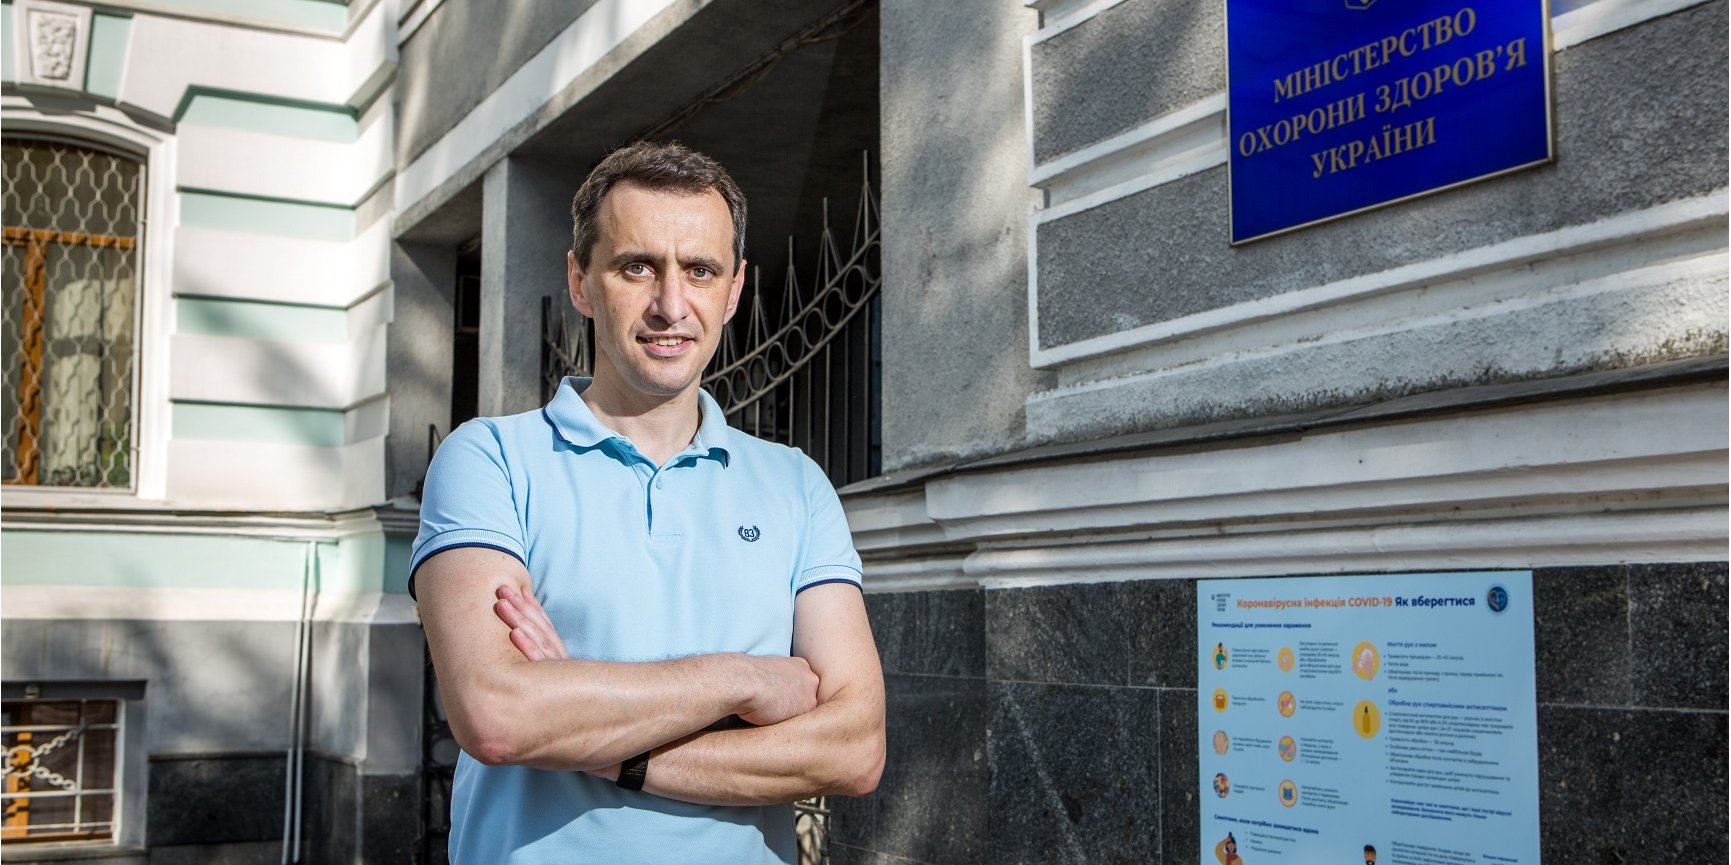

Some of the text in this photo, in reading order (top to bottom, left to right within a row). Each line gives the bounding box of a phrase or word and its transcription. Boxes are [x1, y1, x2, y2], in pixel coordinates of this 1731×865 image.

[1273, 8, 1477, 103] МІНІСТЕРСТВО
[1239, 93, 1366, 157] ОХОРОНИ
[1311, 117, 1437, 179] УКРАЇНИ
[1237, 597, 1301, 609] Коронавірусна
[1304, 596, 1345, 609] інфекція
[1348, 597, 1392, 607] COVID-19
[1395, 597, 1408, 607] Як
[1411, 596, 1475, 609] вберегтися
